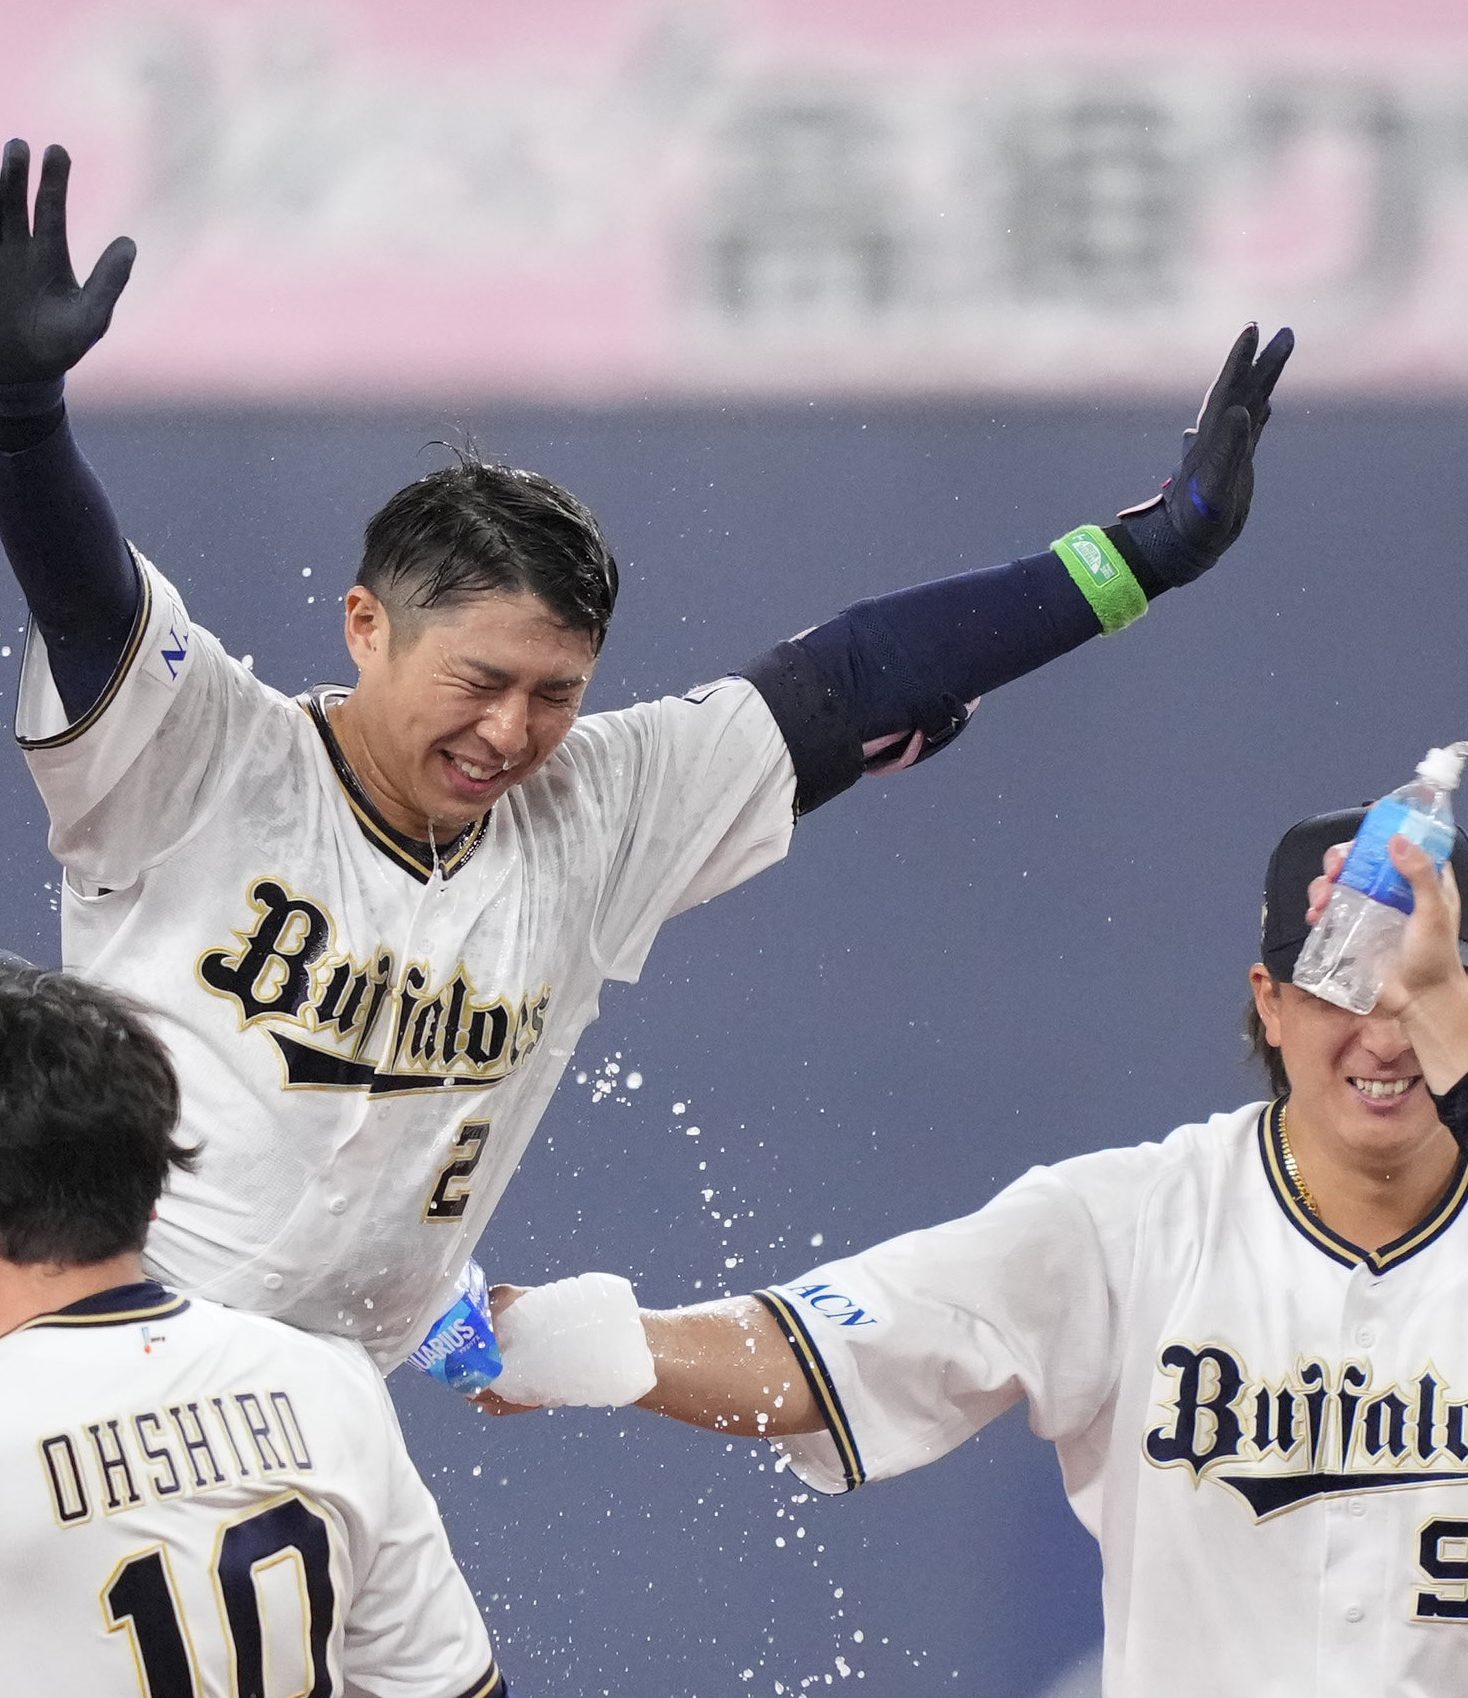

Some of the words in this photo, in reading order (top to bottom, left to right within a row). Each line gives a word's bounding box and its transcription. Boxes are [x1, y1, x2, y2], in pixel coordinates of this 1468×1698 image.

[194, 875, 552, 1076] Buffaloes
[421, 1118, 491, 1224] 2
[787, 1284, 878, 1326] ACN
[38, 1389, 315, 1528] OHSHIRO
